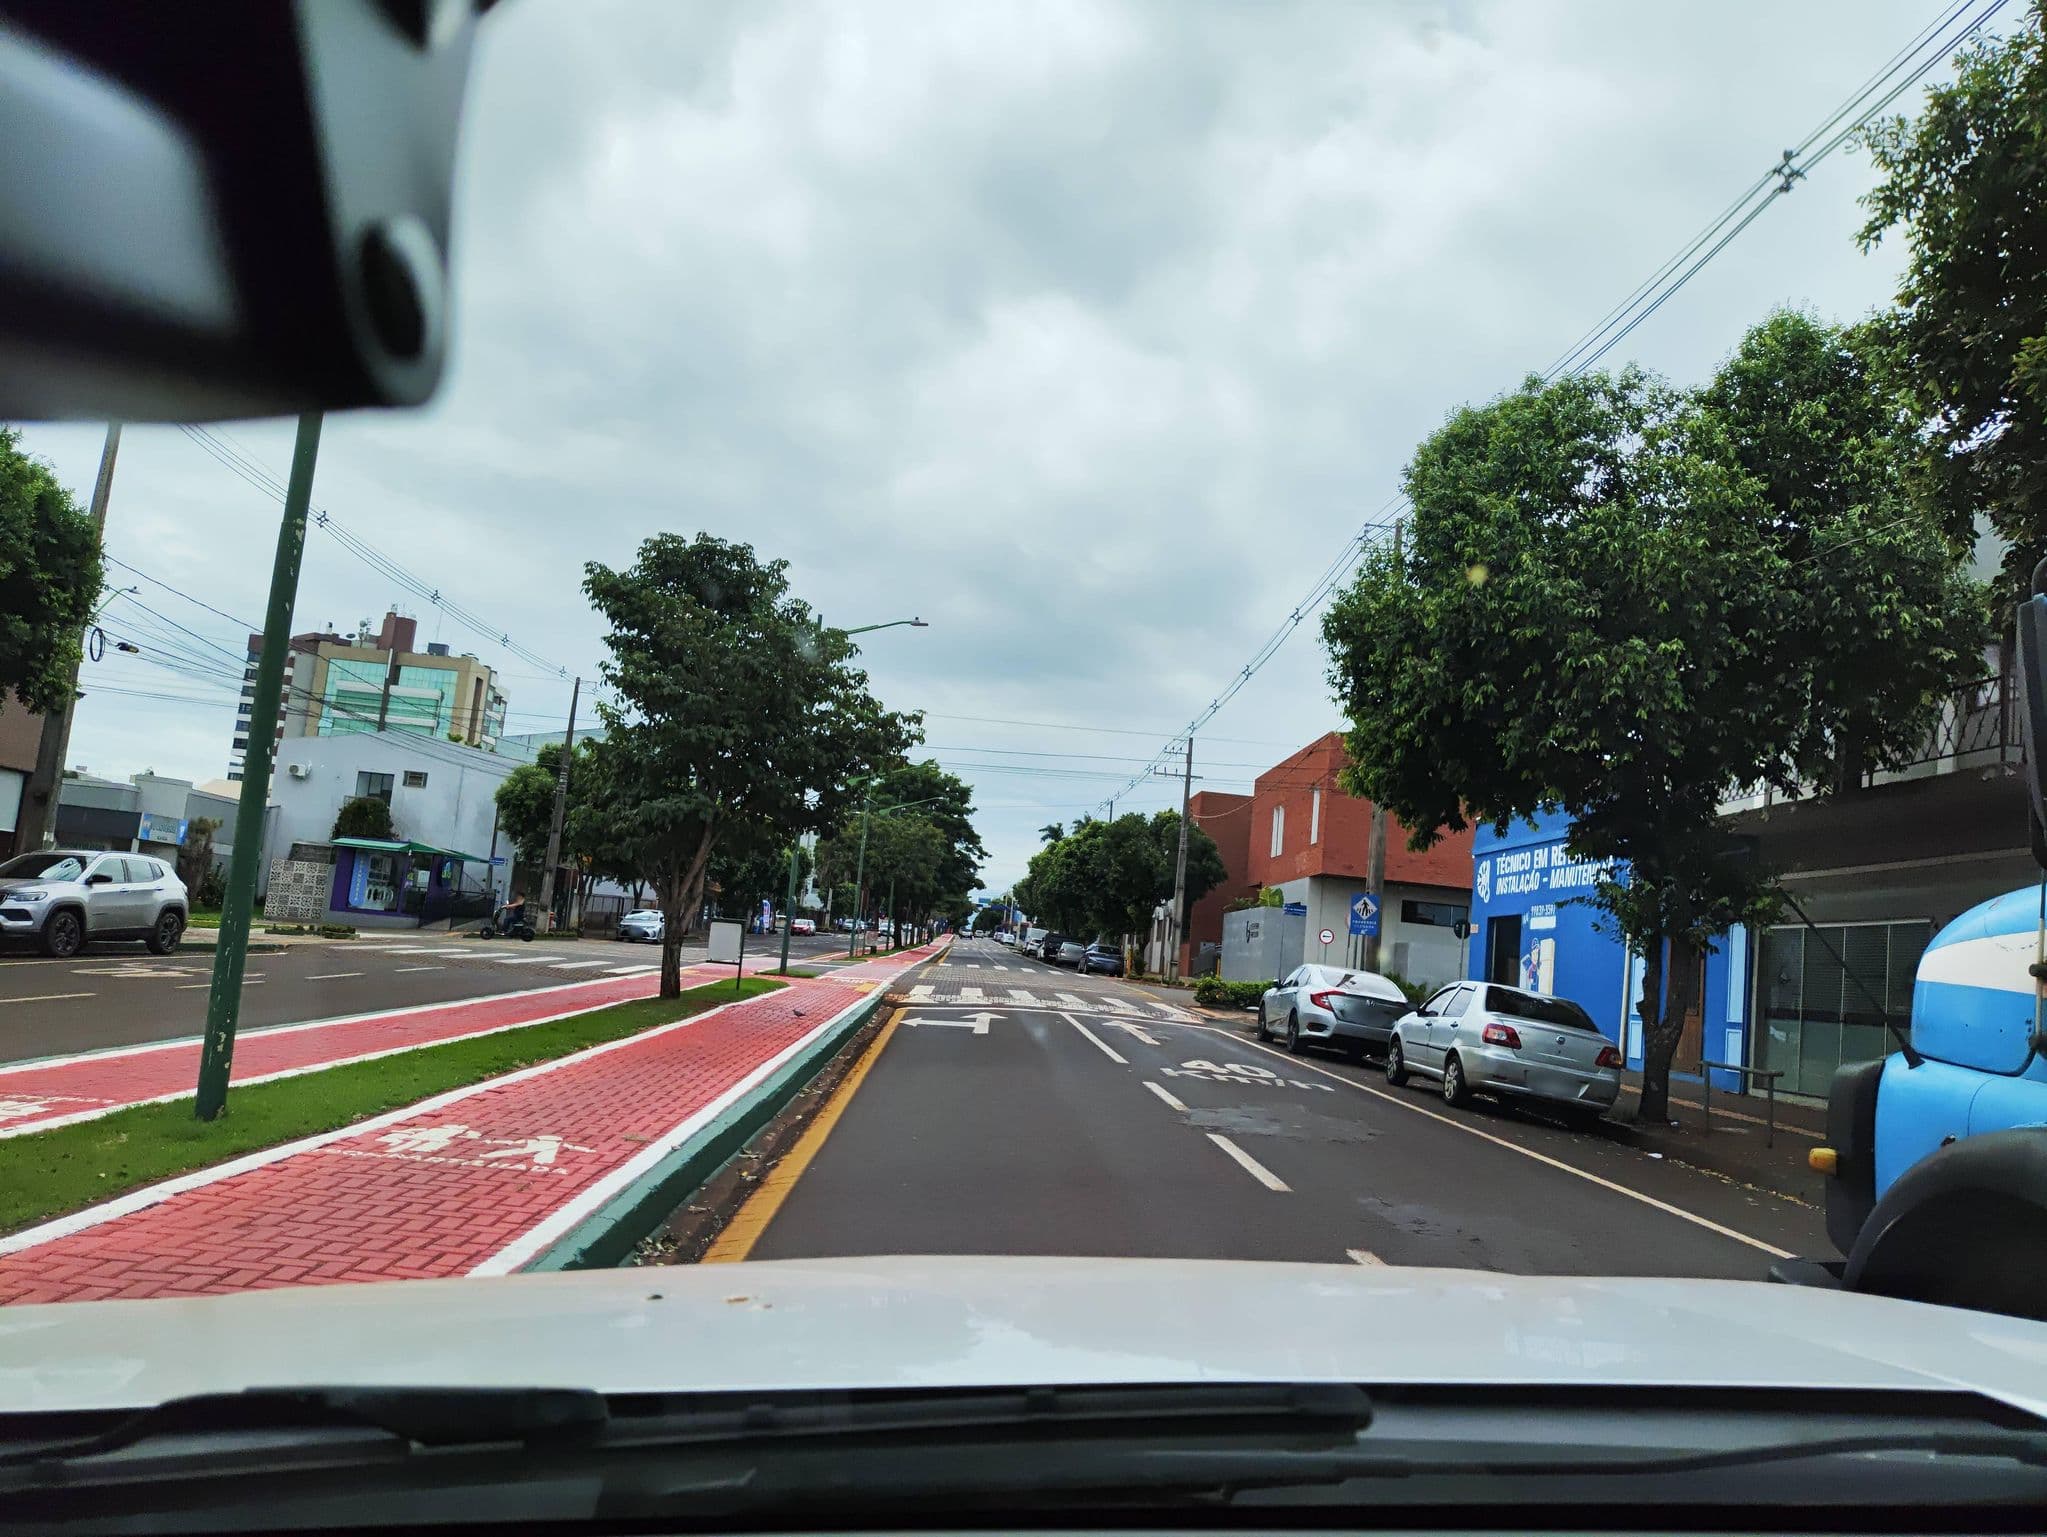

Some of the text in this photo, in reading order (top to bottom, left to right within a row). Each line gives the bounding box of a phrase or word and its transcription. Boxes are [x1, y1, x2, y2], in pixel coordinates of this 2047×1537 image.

[1496, 853, 1531, 875] TÉCNICO
[1534, 847, 1549, 869] EM
[1181, 1060, 1277, 1078] 40
